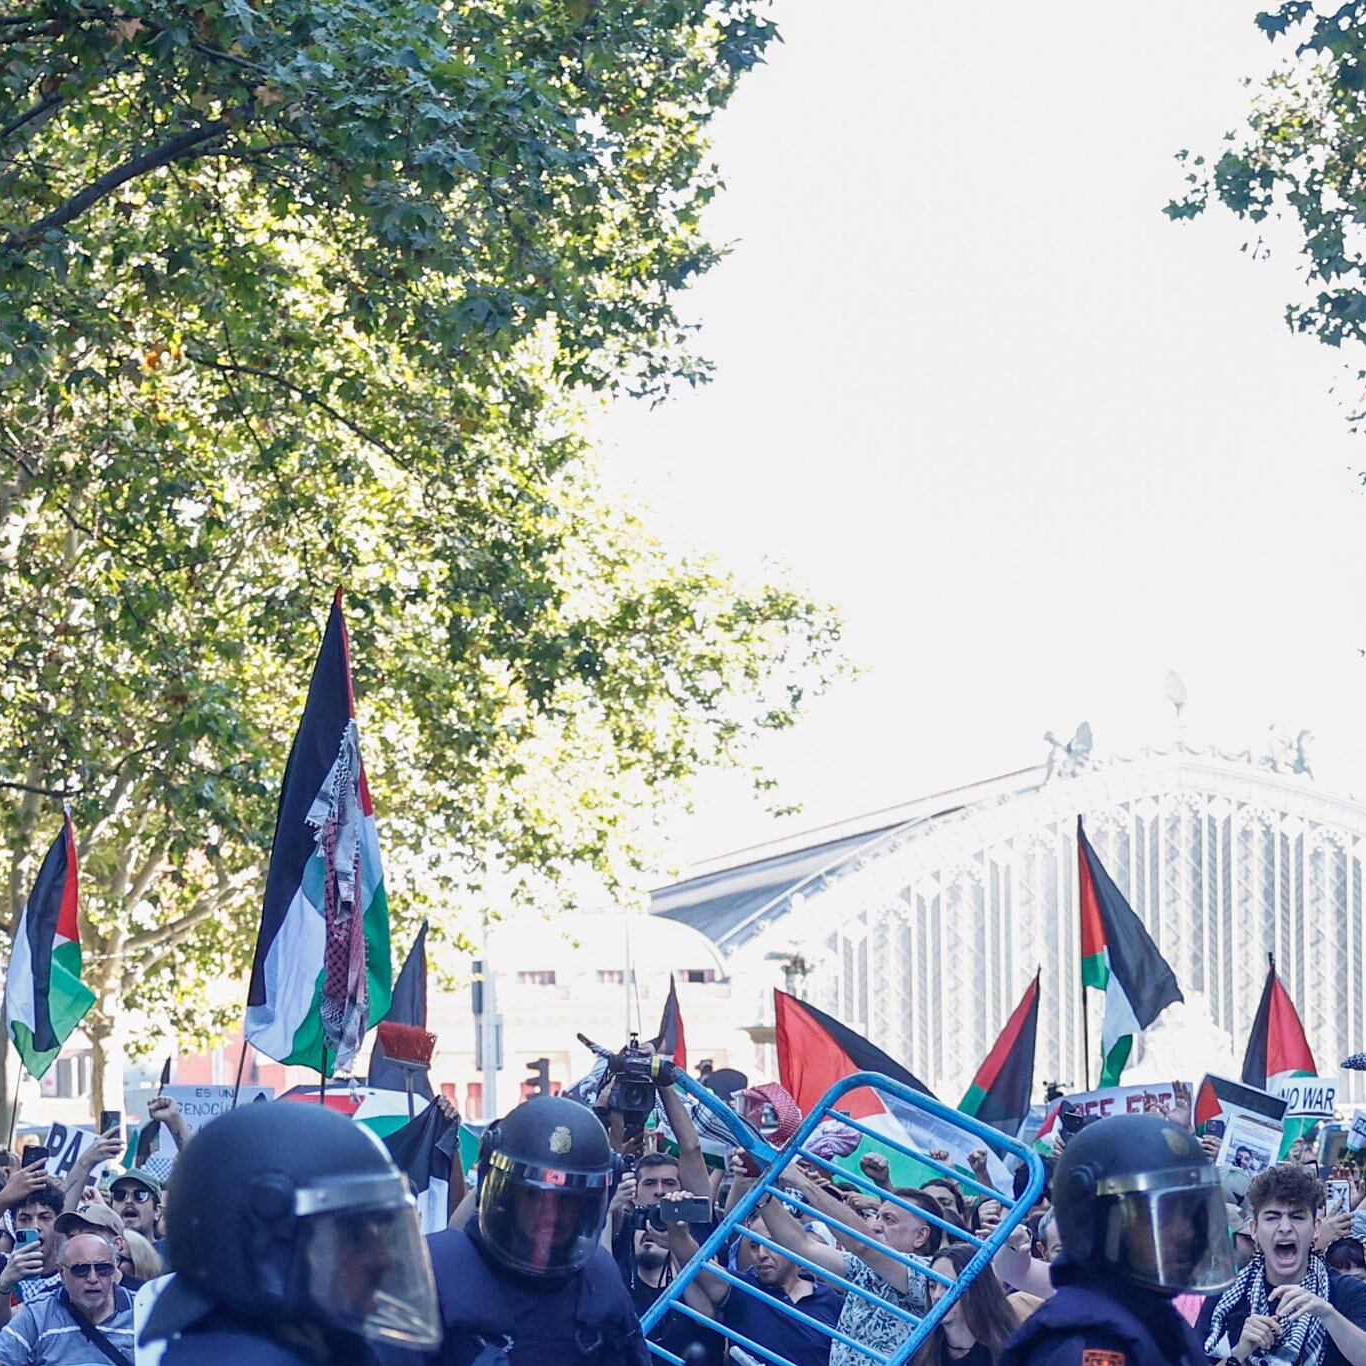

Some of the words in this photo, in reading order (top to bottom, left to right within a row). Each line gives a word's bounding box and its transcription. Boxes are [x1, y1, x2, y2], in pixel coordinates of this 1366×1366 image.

[195, 1088, 211, 1098] ES
[218, 1088, 235, 1098] UN
[1302, 1087, 1335, 1111] WAR
